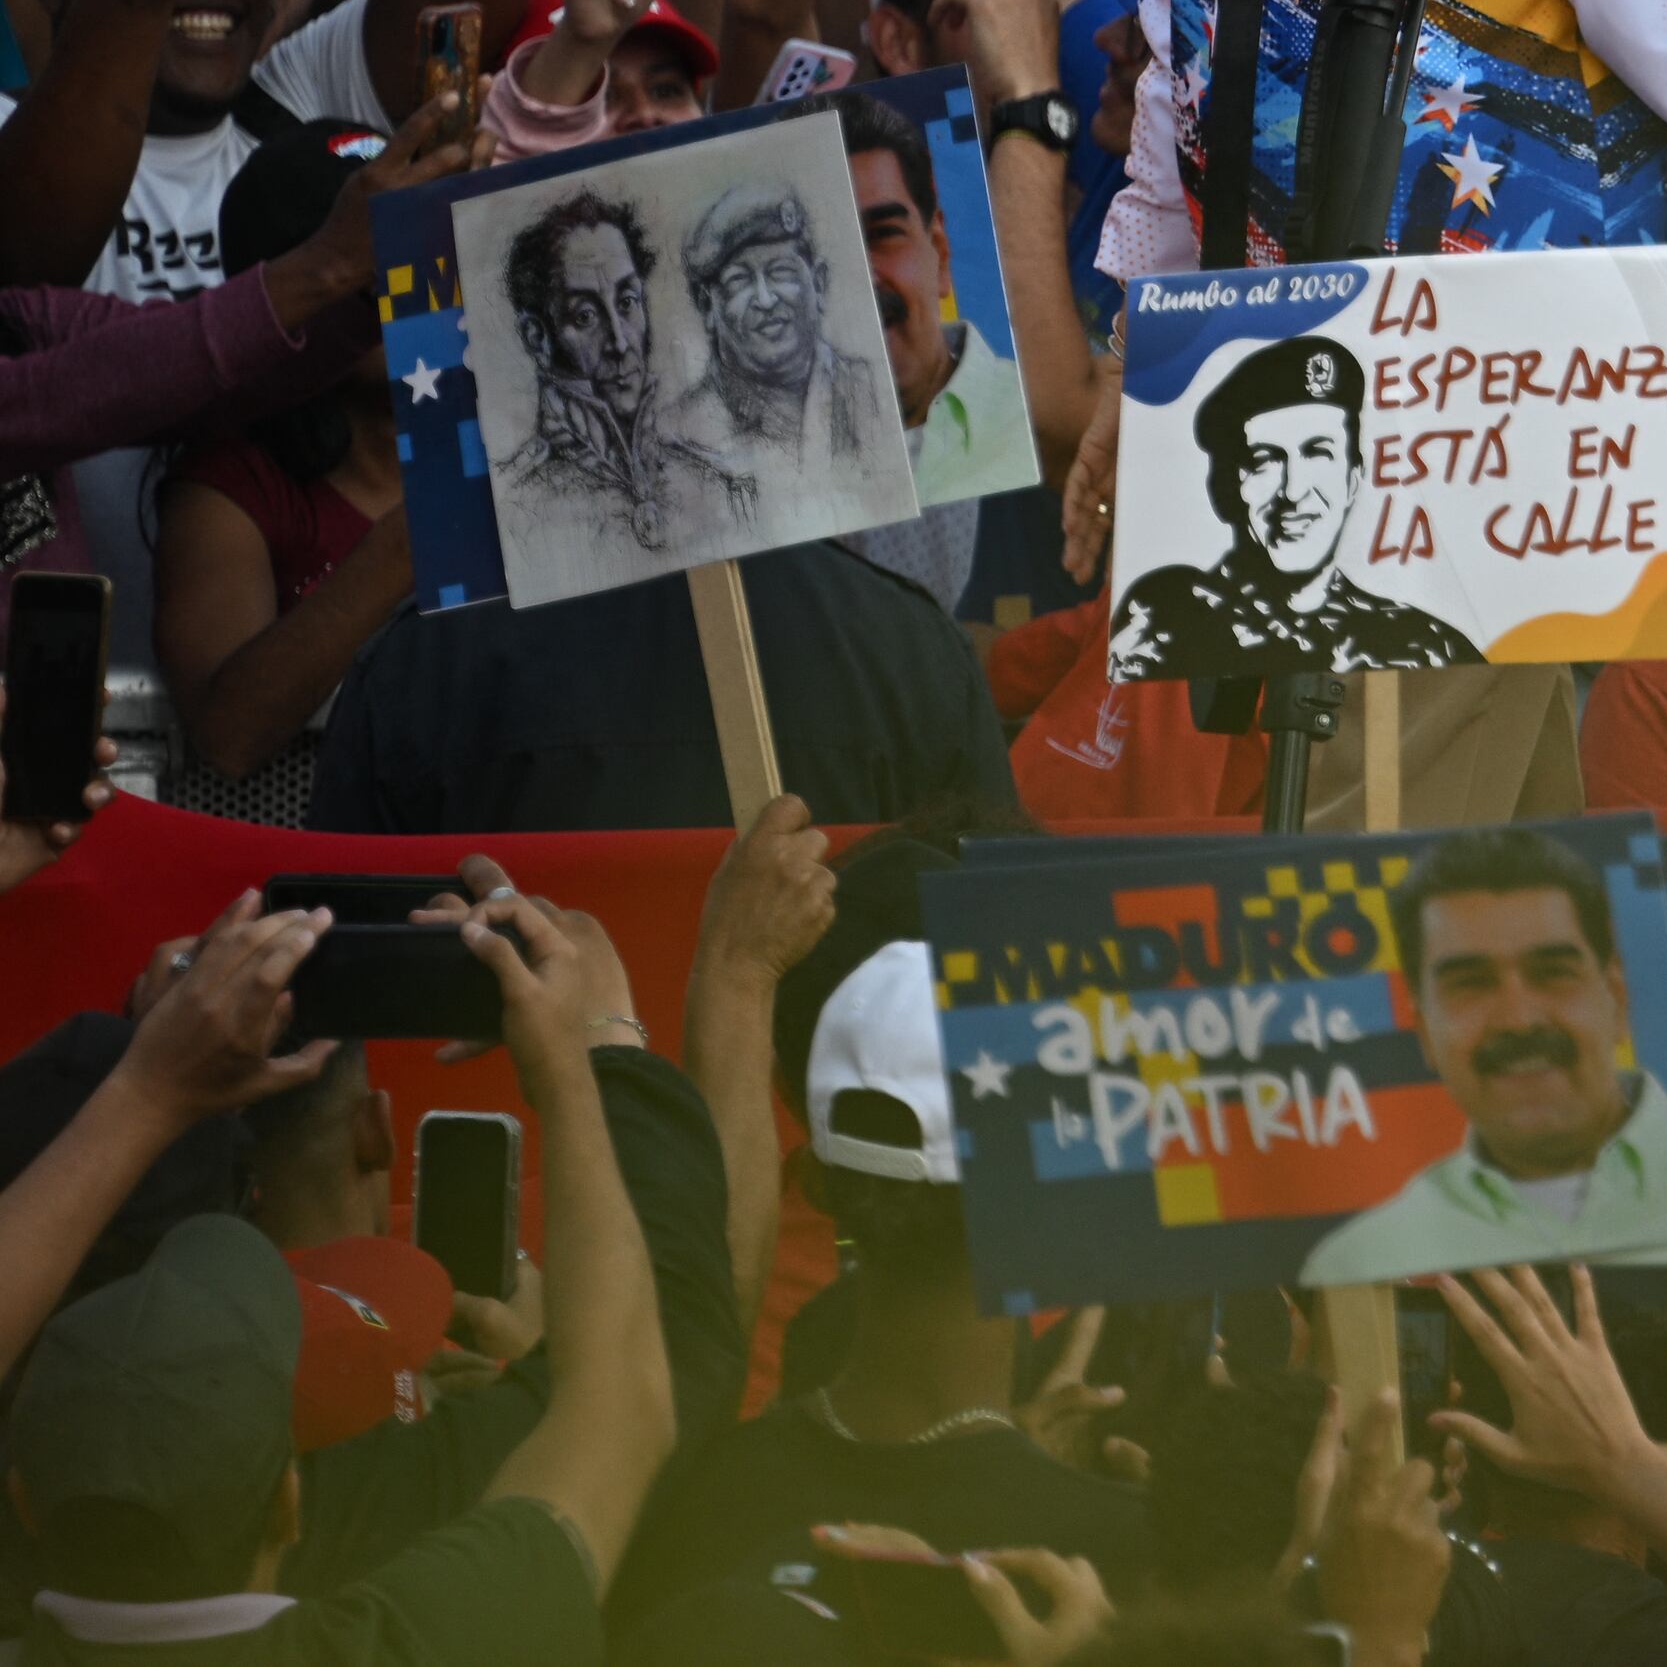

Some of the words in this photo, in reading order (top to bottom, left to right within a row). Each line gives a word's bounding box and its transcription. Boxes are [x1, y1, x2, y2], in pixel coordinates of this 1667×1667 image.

[1137, 283, 1238, 315] Rumbo
[1245, 281, 1279, 307] al
[1288, 272, 1355, 303] 2030
[1369, 265, 1438, 336] LA
[1371, 413, 1513, 487] ESTÁ
[1567, 424, 1636, 480] EN
[1367, 494, 1435, 566] LA
[1484, 484, 1658, 560] CALLE
[1031, 985, 1280, 1076] amor
[1289, 992, 1362, 1052] de
[1051, 1095, 1086, 1150] la
[1088, 1061, 1378, 1170] PATRIA
